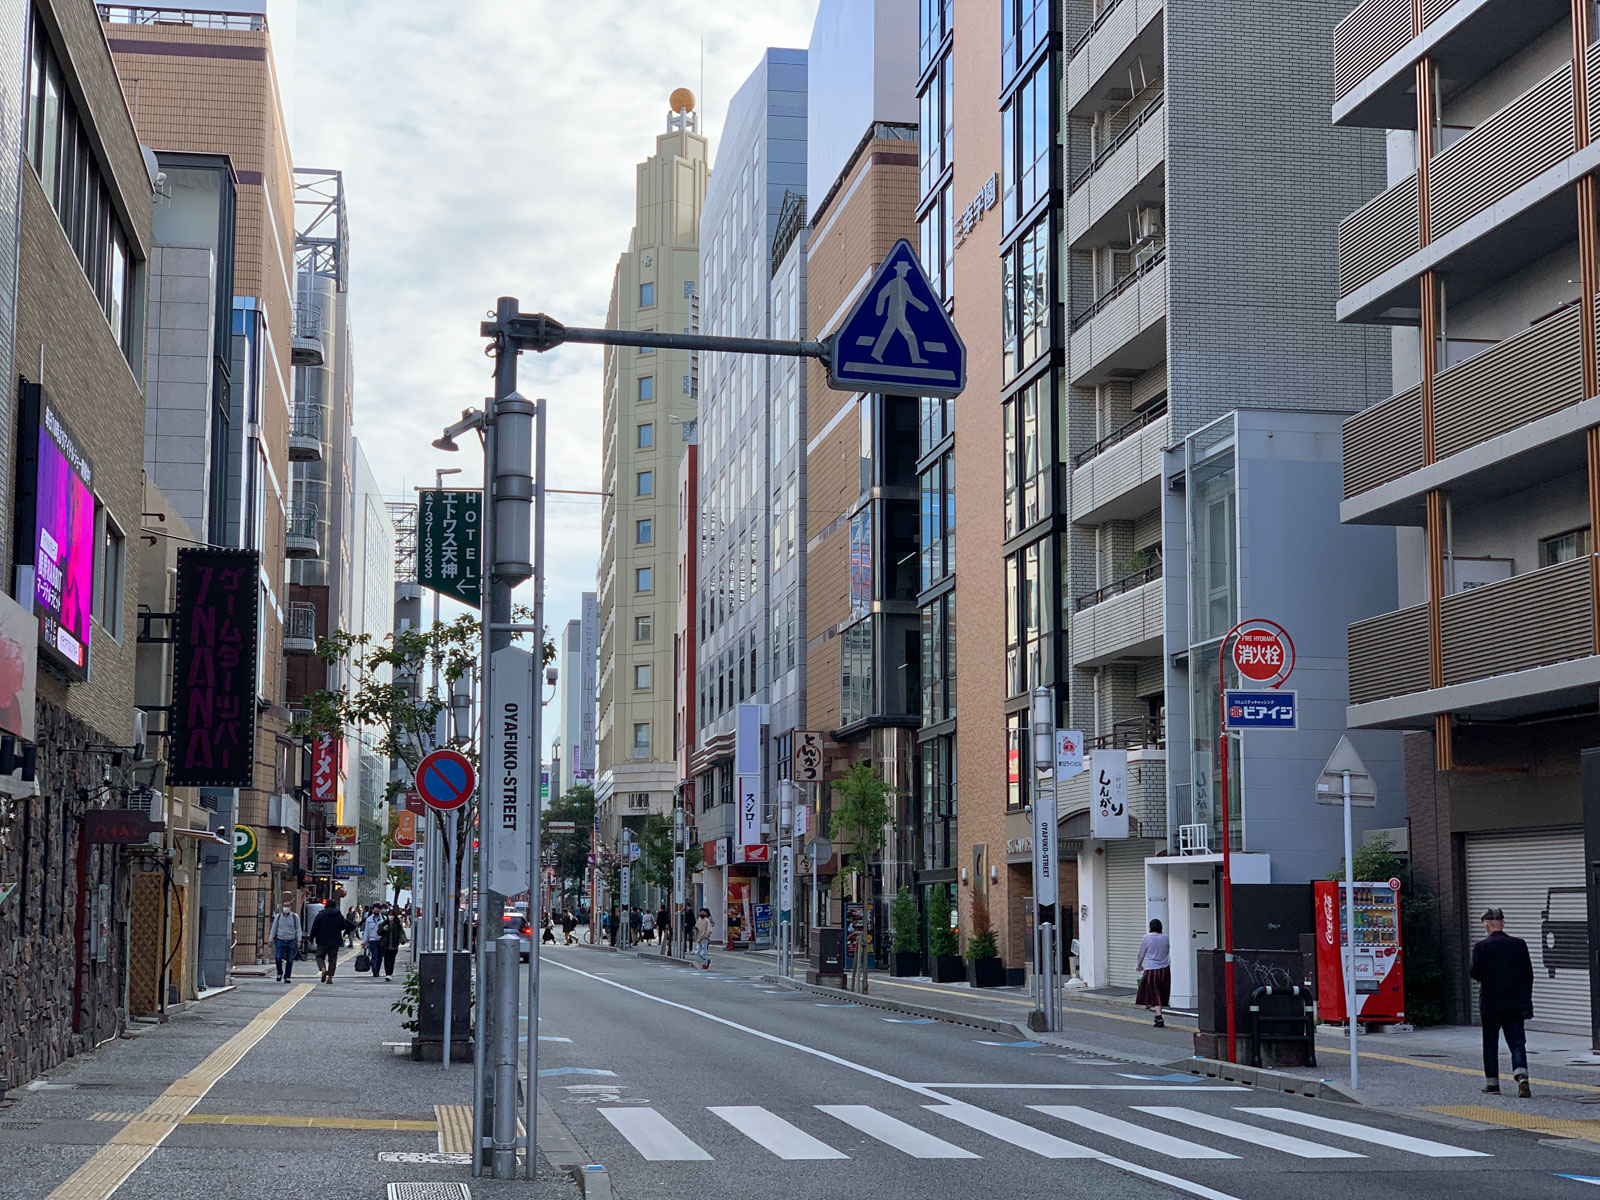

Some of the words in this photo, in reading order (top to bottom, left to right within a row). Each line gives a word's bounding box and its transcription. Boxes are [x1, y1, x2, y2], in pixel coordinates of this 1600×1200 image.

[425, 502, 433, 579] 737-3233
[441, 492, 458, 578] エトワス天神
[465, 493, 477, 578] HOTEL
[1238, 645, 1280, 664] 消火栓
[1243, 705, 1293, 719] ビアイジ
[503, 703, 519, 831] OYAFUKO-STREET
[802, 734, 817, 780] とんかつ
[744, 793, 755, 829] スシロー
[1099, 769, 1124, 816] しんがり
[233, 832, 248, 853] P
[1041, 822, 1050, 878] OYAFUKO-STREET
[243, 861, 256, 873] 空
[756, 906, 763, 917] P
